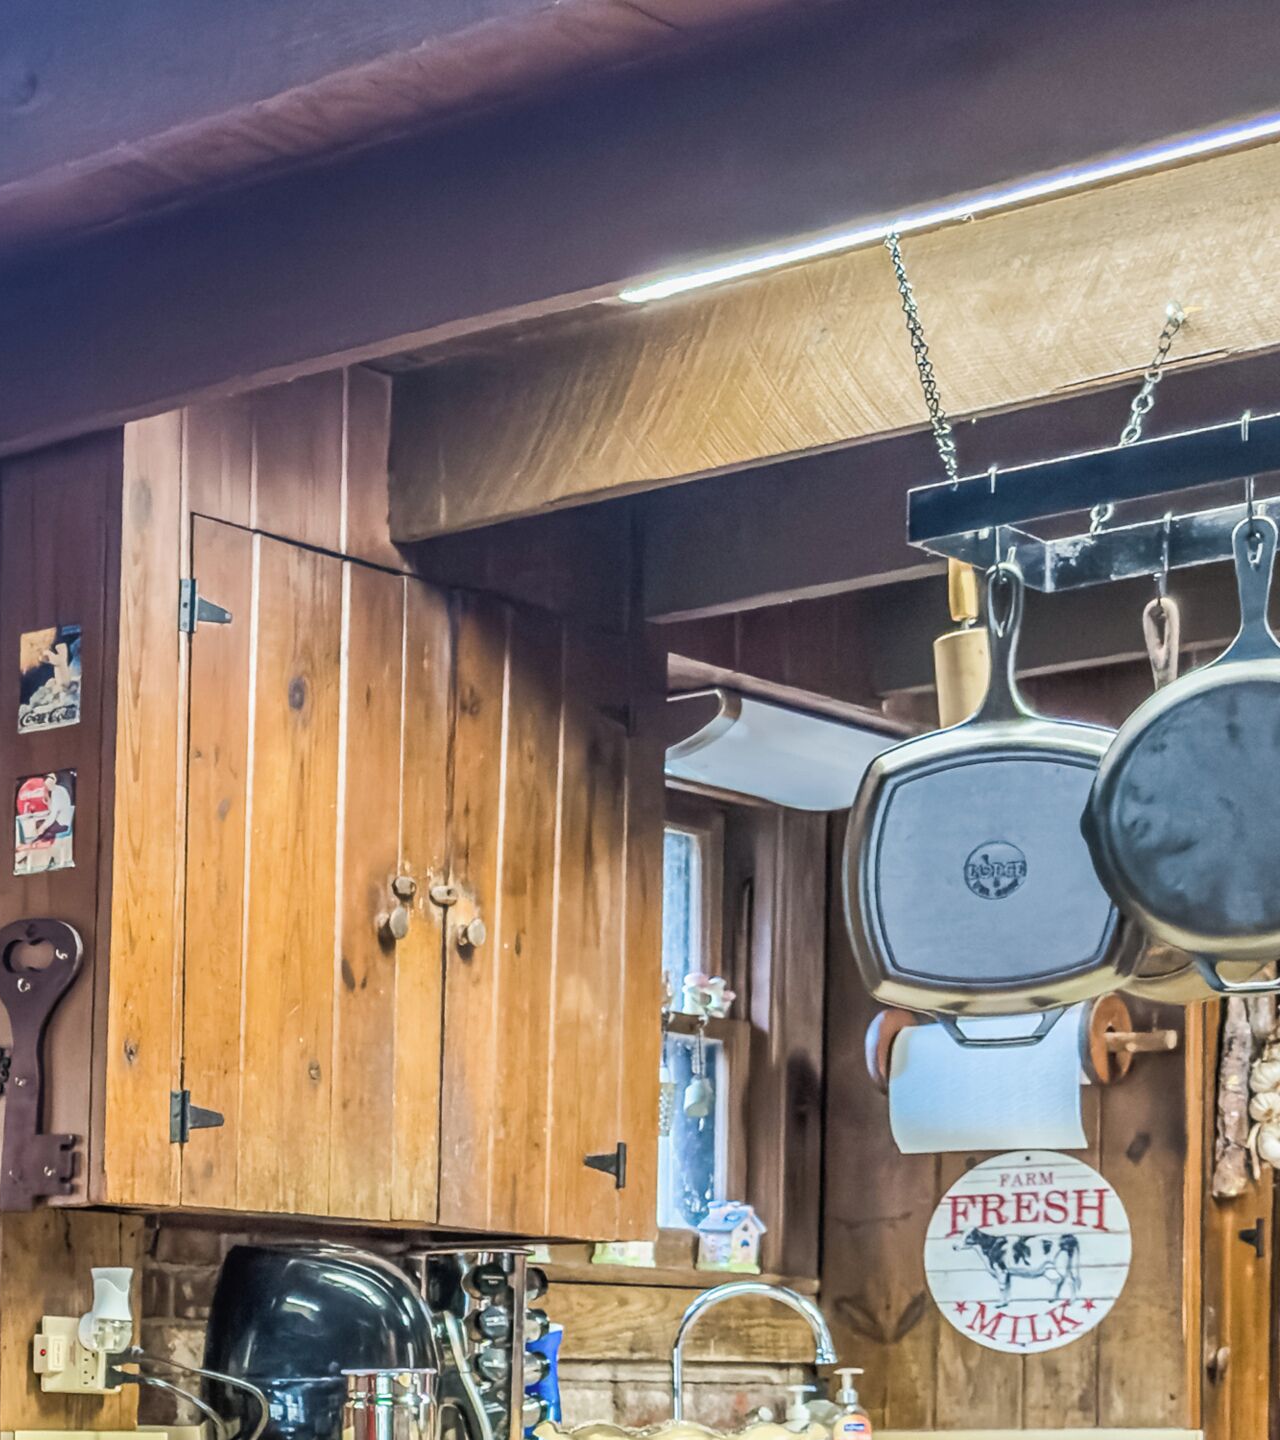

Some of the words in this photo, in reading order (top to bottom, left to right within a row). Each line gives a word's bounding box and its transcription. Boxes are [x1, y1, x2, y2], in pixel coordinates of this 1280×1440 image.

[999, 1171, 1055, 1188] FARM
[944, 1187, 1111, 1239] FRESH
[964, 1300, 1084, 1345] MILK
